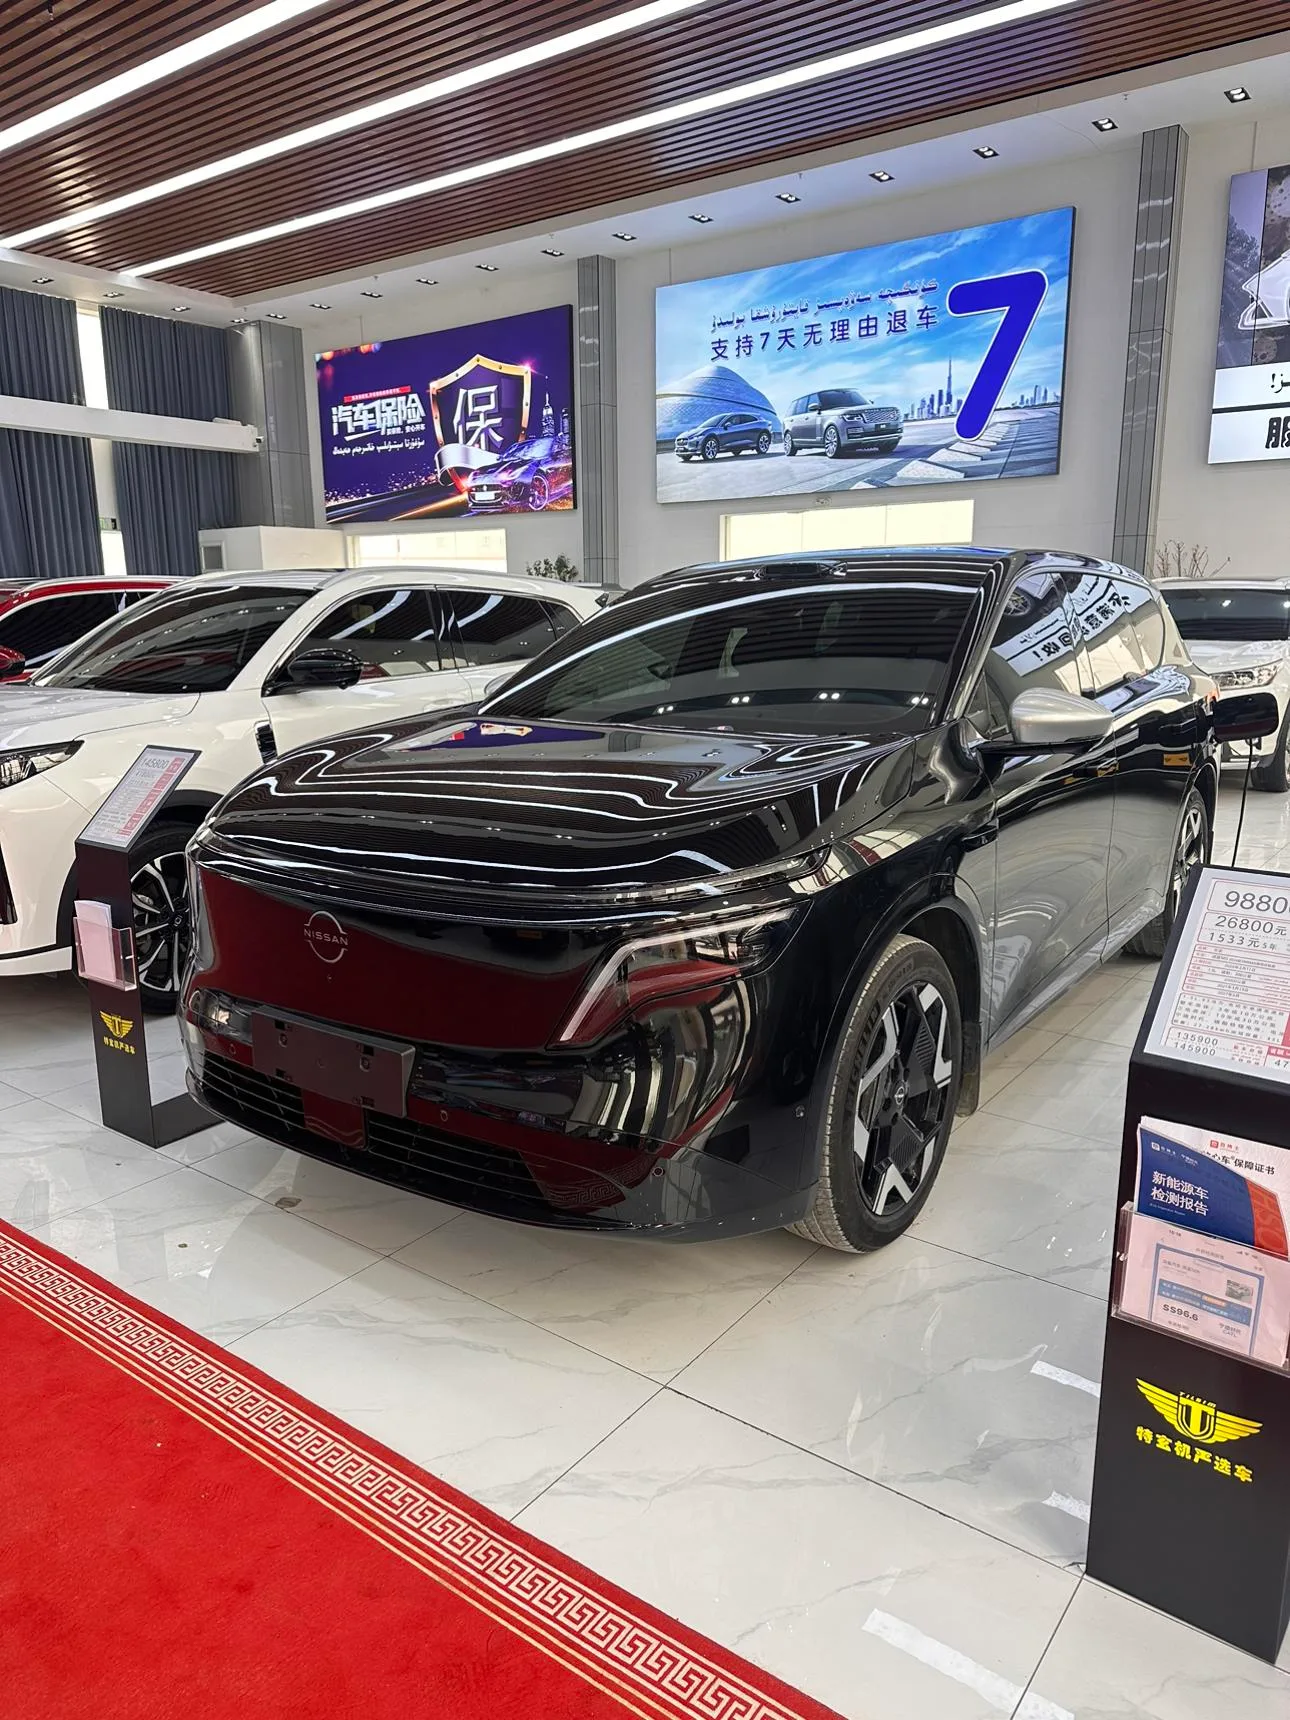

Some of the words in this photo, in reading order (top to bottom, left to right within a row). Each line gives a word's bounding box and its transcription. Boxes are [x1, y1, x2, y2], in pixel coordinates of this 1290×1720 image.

[711, 305, 937, 361] 支持7天无理由退车
[947, 269, 1049, 441] 7
[332, 393, 426, 437] 汽车保险
[453, 385, 504, 450] 保
[1224, 890, 1290, 914] 9880
[303, 928, 349, 946] NISSAN
[1215, 915, 1287, 936] 26800元
[1209, 932, 1260, 948] 1533元
[1174, 1042, 1216, 1056] 145900
[1177, 1031, 1218, 1046] 135900
[1152, 1170, 1209, 1200] 新能源车
[1150, 1187, 1209, 1217] 检测报告
